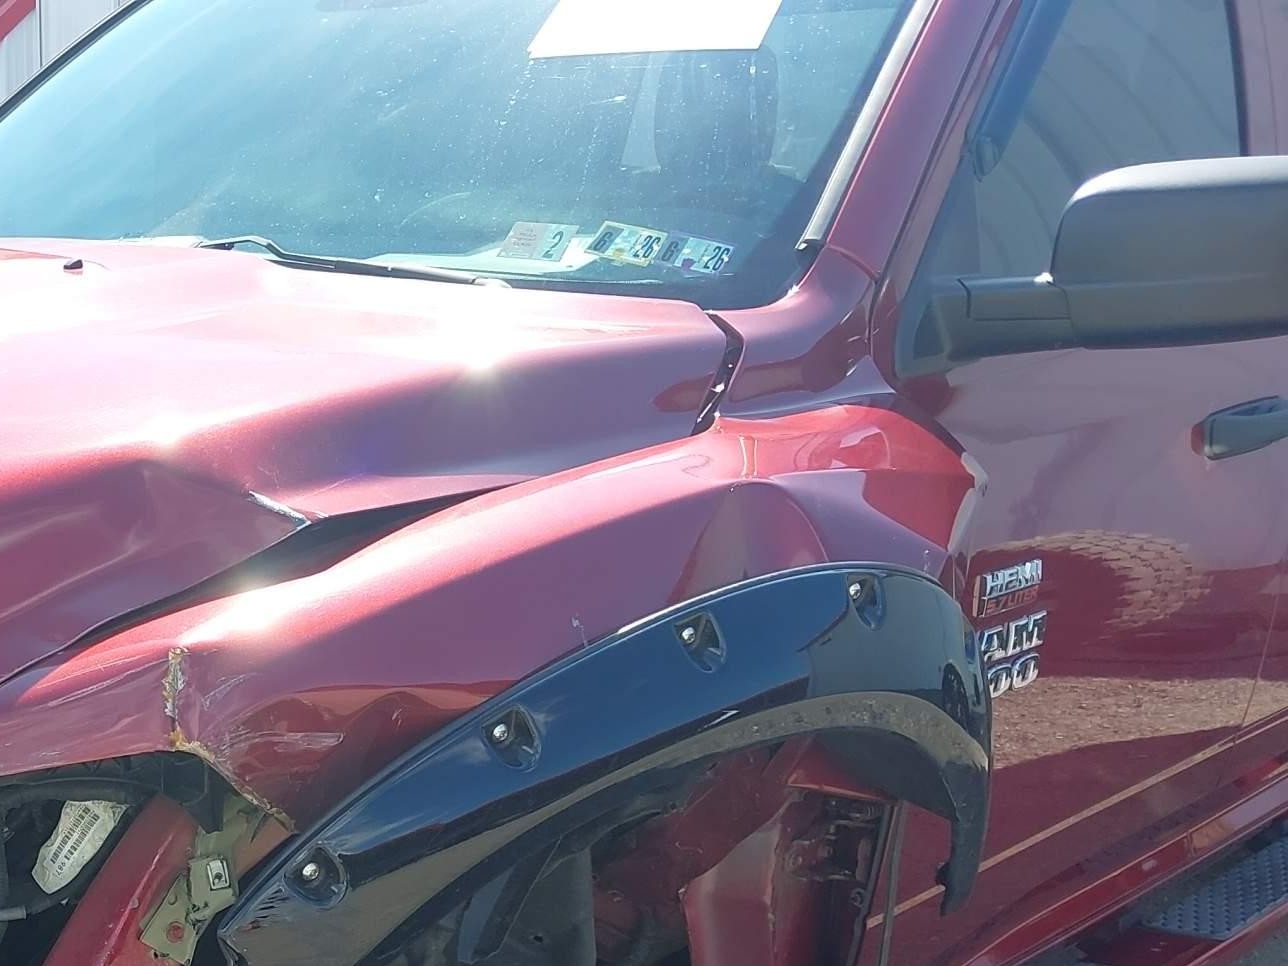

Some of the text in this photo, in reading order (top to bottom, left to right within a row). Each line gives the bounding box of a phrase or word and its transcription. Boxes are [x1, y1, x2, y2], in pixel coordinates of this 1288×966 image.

[541, 230, 564, 259] 2
[594, 231, 661, 259] 6 26
[662, 240, 730, 272] 6 26
[984, 559, 1042, 598] HEMI
[1007, 585, 1039, 607] LITER
[979, 610, 1047, 663] AM
